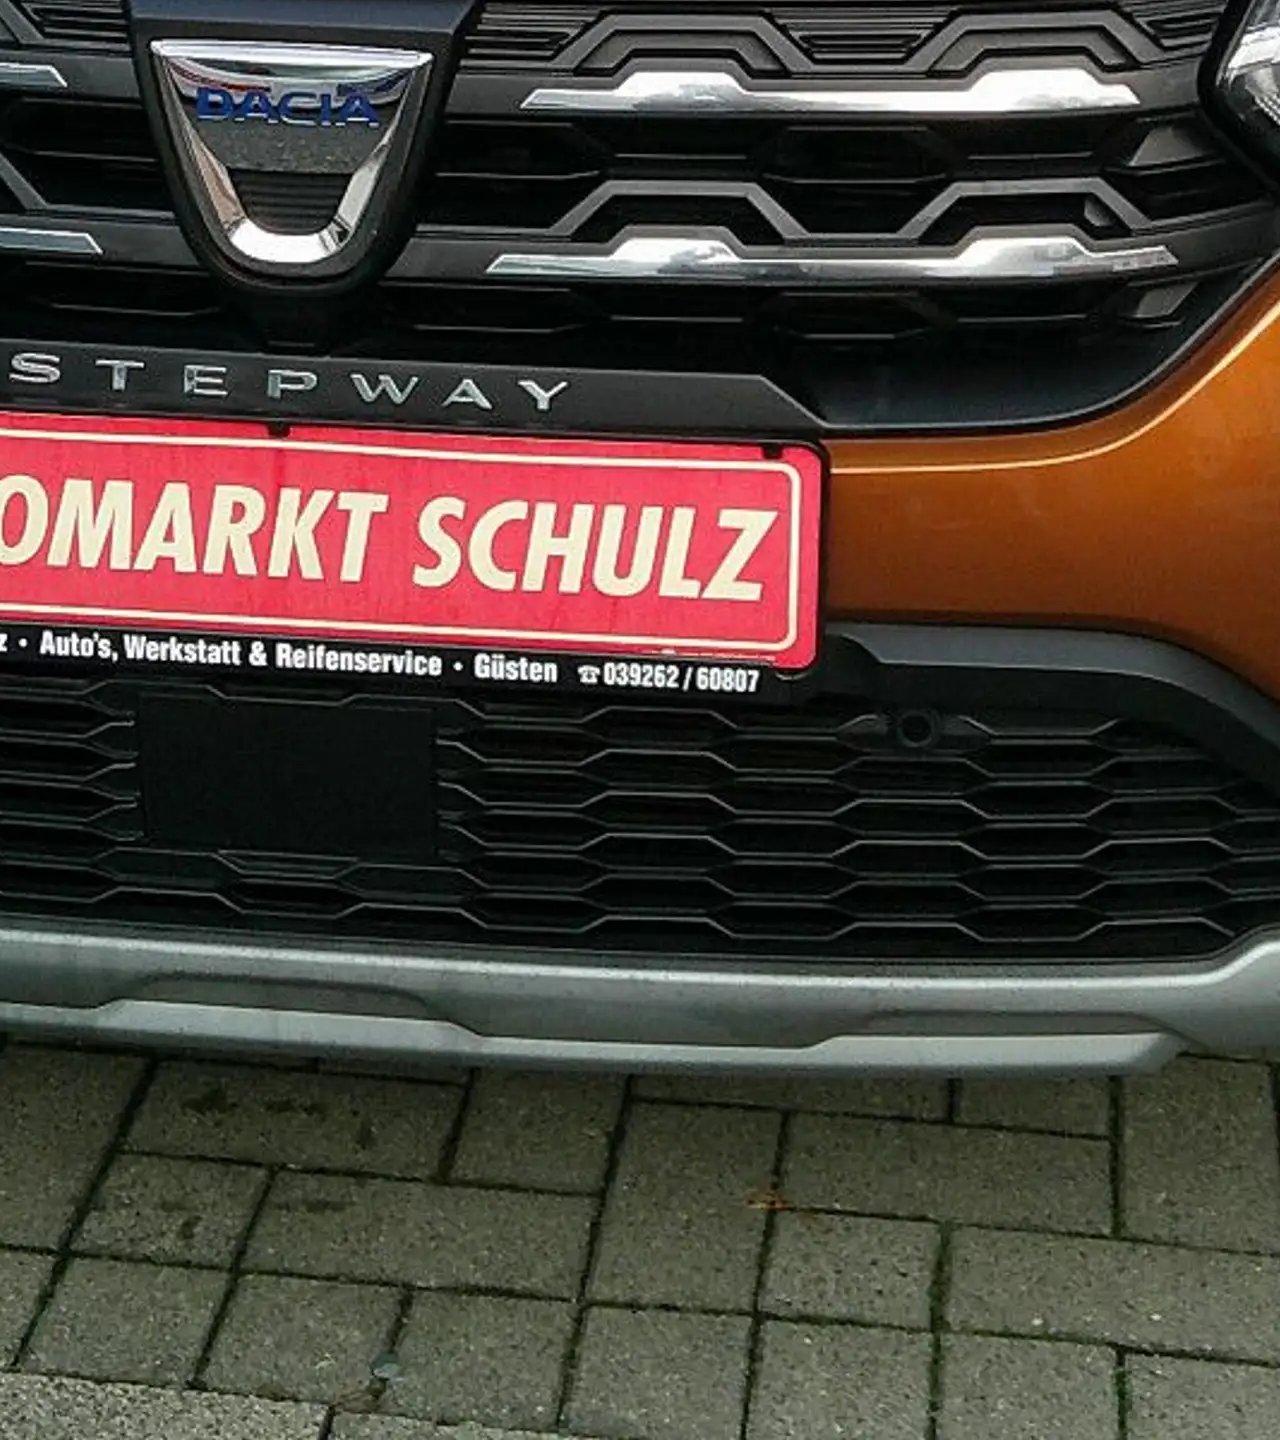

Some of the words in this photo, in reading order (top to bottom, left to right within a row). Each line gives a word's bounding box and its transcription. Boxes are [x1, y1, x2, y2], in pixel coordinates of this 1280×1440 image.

[195, 86, 380, 127] DACIA
[7, 352, 569, 411] STEPWAY
[412, 496, 779, 601] SCHULZ
[39, 630, 118, 662] Auto's,
[123, 634, 241, 666] Werkstatt
[248, 641, 267, 667] &
[275, 642, 443, 677] Reifenservice
[474, 652, 558, 683] Güsten
